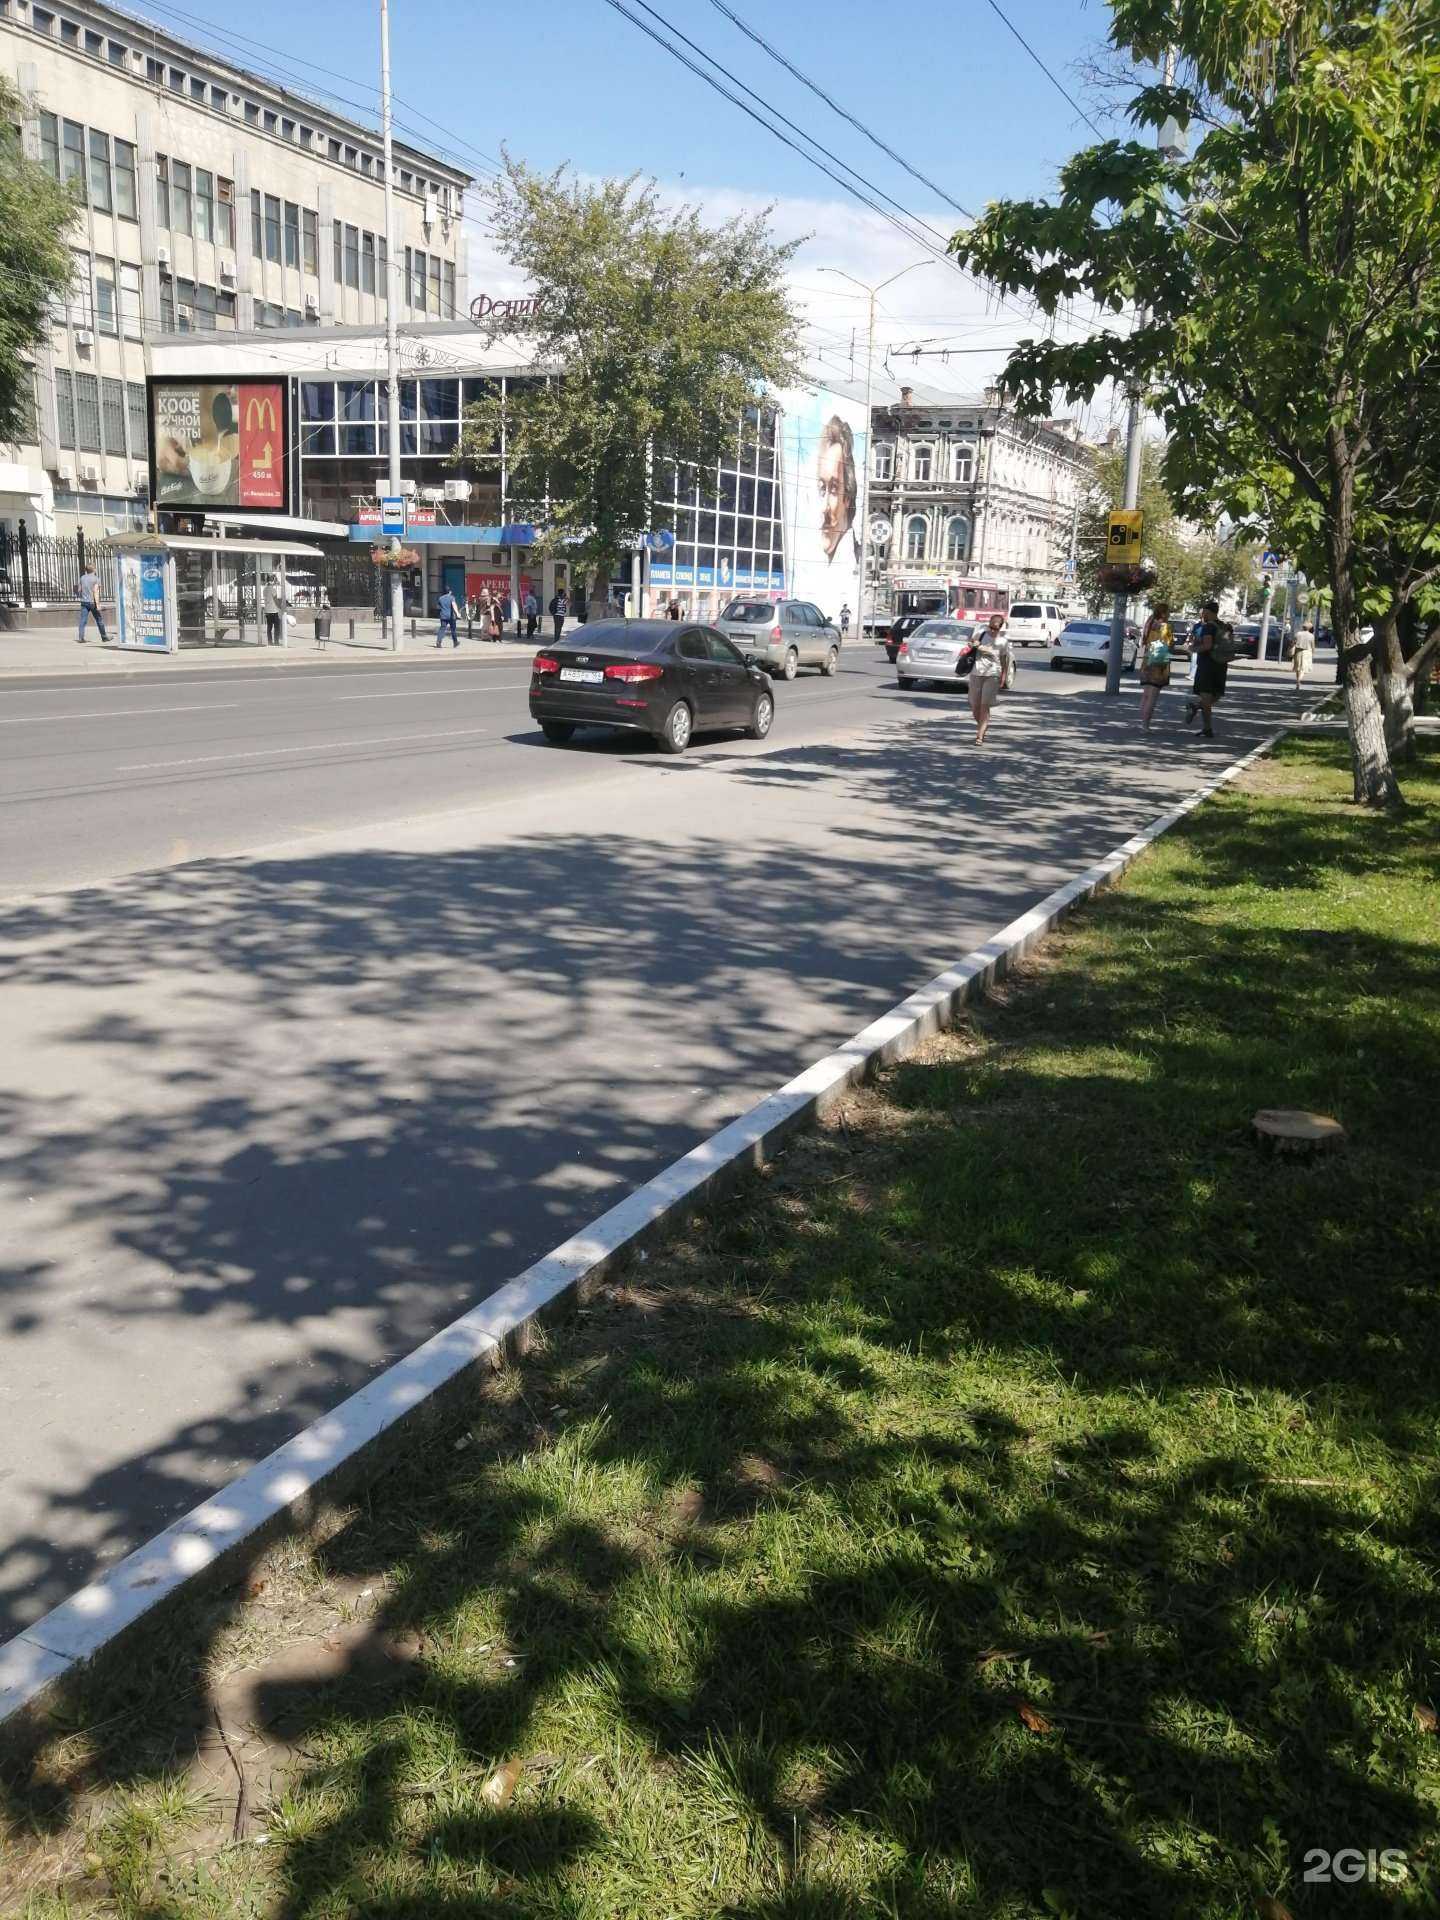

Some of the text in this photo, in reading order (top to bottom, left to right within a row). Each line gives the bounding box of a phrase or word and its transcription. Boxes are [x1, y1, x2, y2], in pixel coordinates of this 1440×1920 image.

[158, 398, 201, 414] КОФЕ
[158, 413, 201, 426] РУЧНОЙ
[158, 427, 201, 439] РАБОТЫ
[360, 513, 382, 522] АРЕНД
[481, 579, 511, 590] АРЕНД
